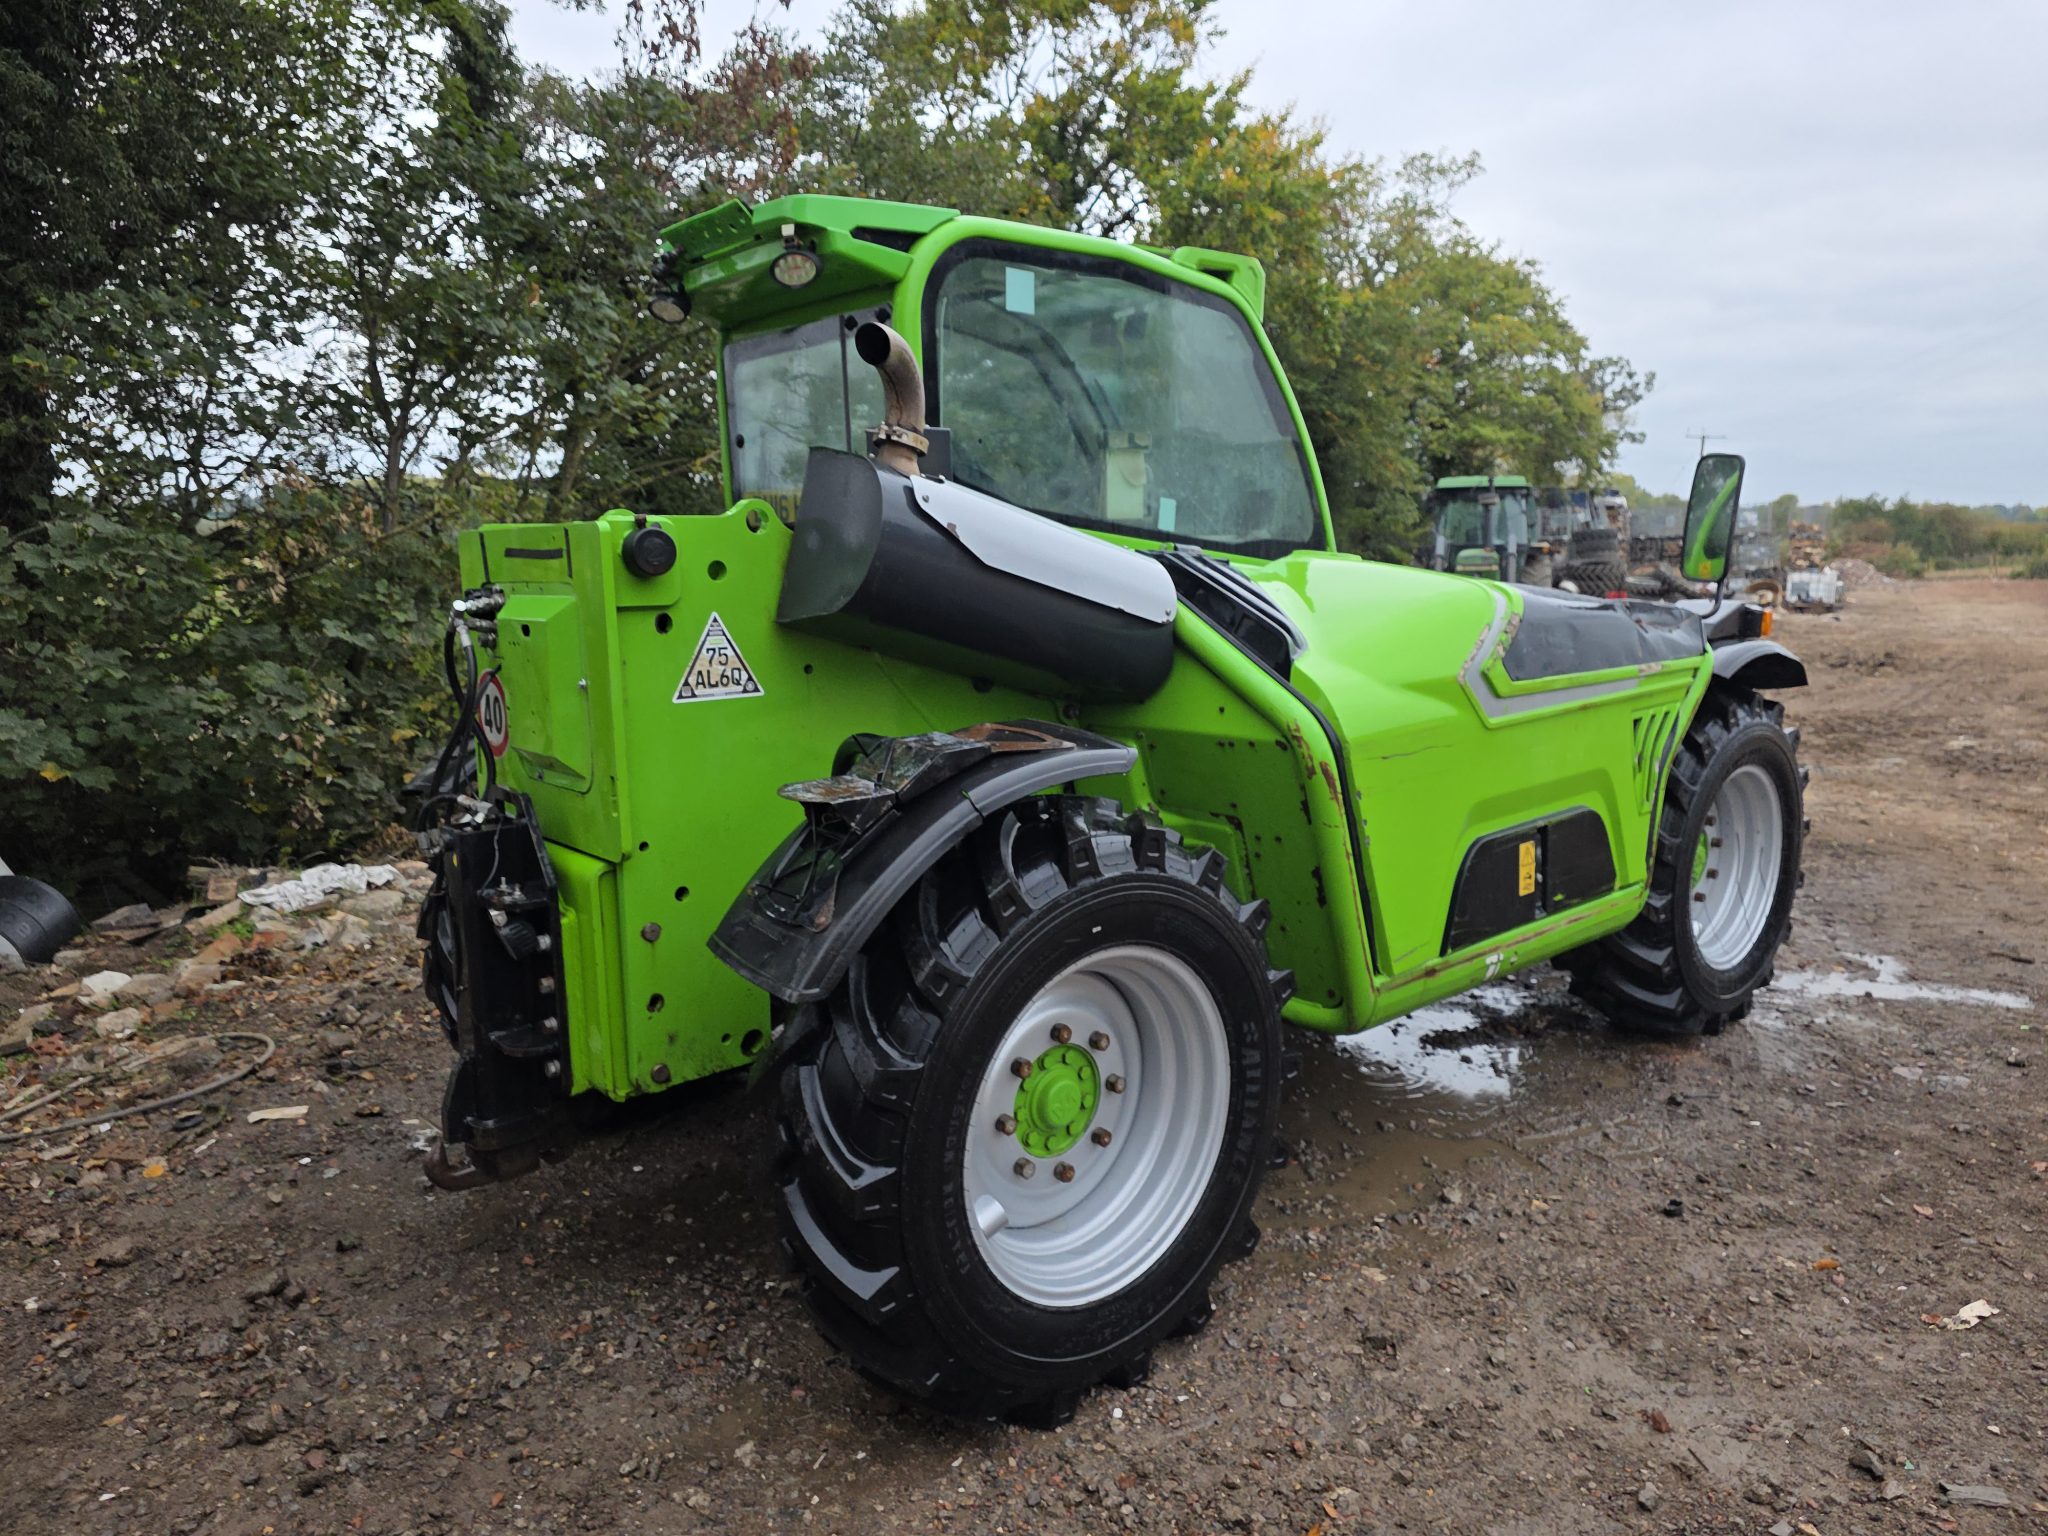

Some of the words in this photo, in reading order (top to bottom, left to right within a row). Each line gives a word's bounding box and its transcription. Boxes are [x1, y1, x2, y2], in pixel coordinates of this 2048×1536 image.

[706, 647, 729, 667] 75
[695, 667, 743, 690] AL6Q
[484, 694, 503, 735] 40
